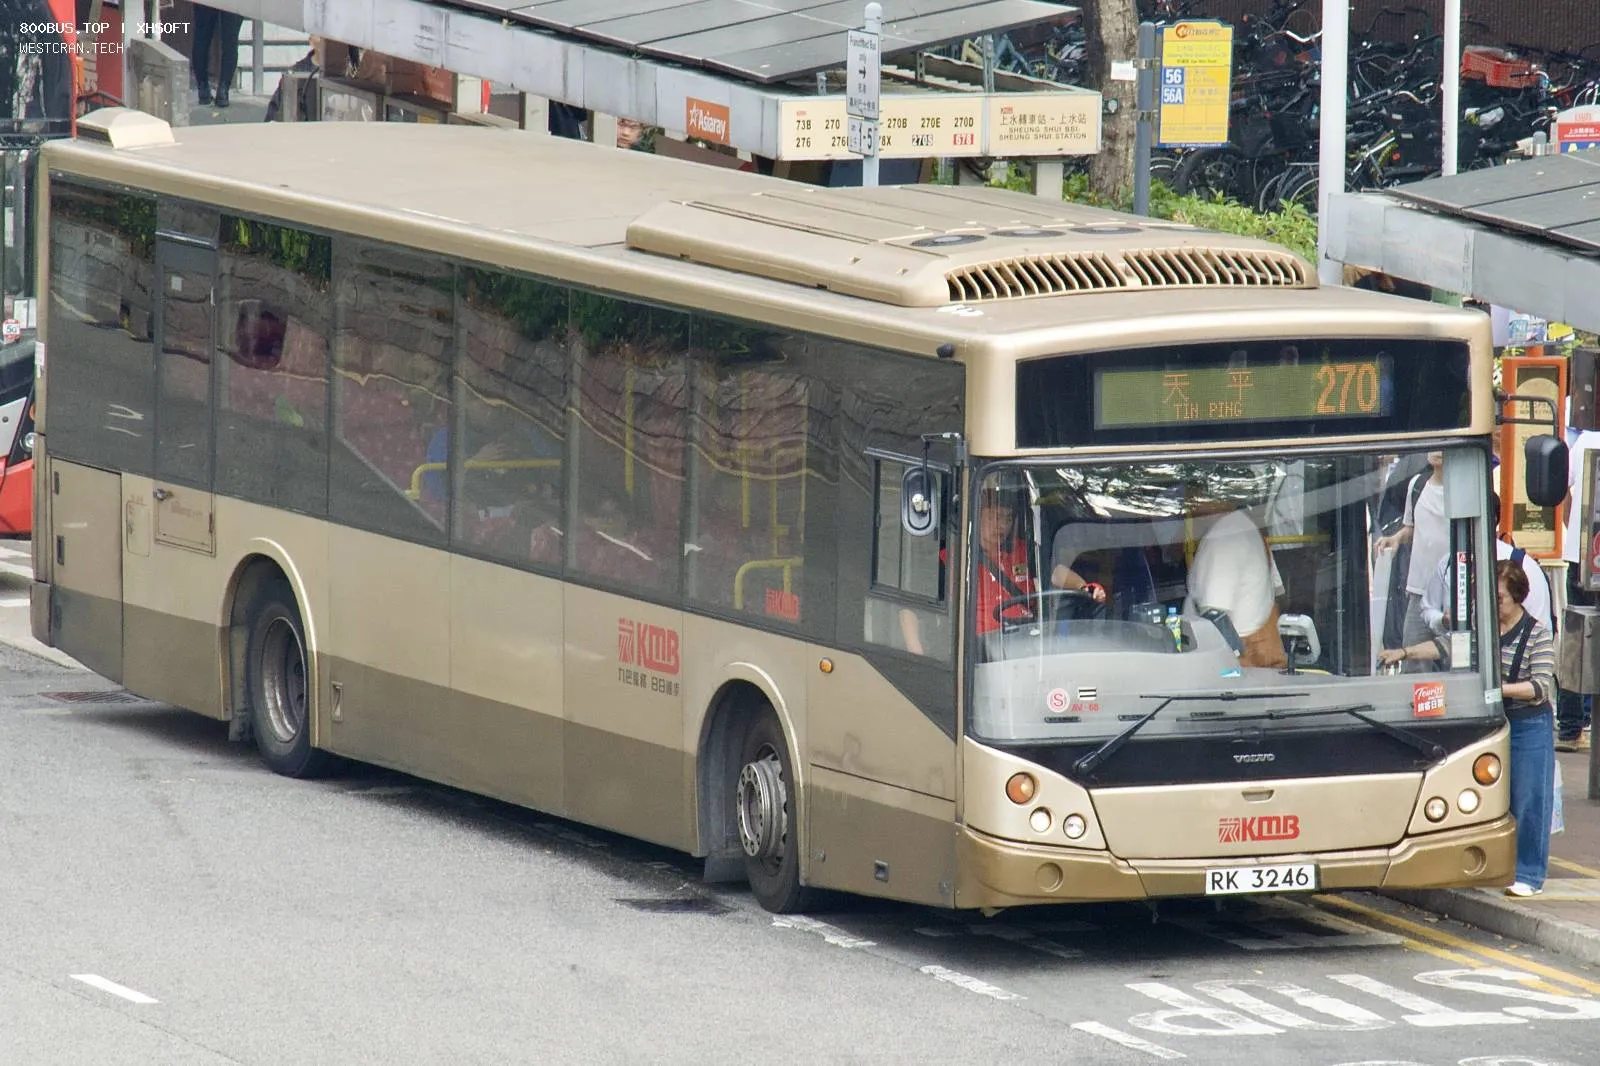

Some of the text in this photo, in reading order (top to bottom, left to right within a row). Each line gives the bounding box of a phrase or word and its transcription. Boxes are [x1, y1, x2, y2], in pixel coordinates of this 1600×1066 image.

[1165, 69, 1182, 84] 56
[1163, 88, 1183, 103] 56A
[698, 108, 726, 141] Asiaray
[796, 116, 974, 130] 73B 270 270B 270E 270D
[796, 136, 811, 148] 276
[1055, 132, 1087, 140] STATION
[1162, 371, 1254, 404] 天平
[1315, 363, 1378, 414] 270
[1174, 401, 1243, 421] TIN PING
[636, 622, 680, 676] KMB
[1232, 753, 1276, 764] VOLVO
[1241, 815, 1300, 842] KMB
[1211, 867, 1309, 891] RK 3246
